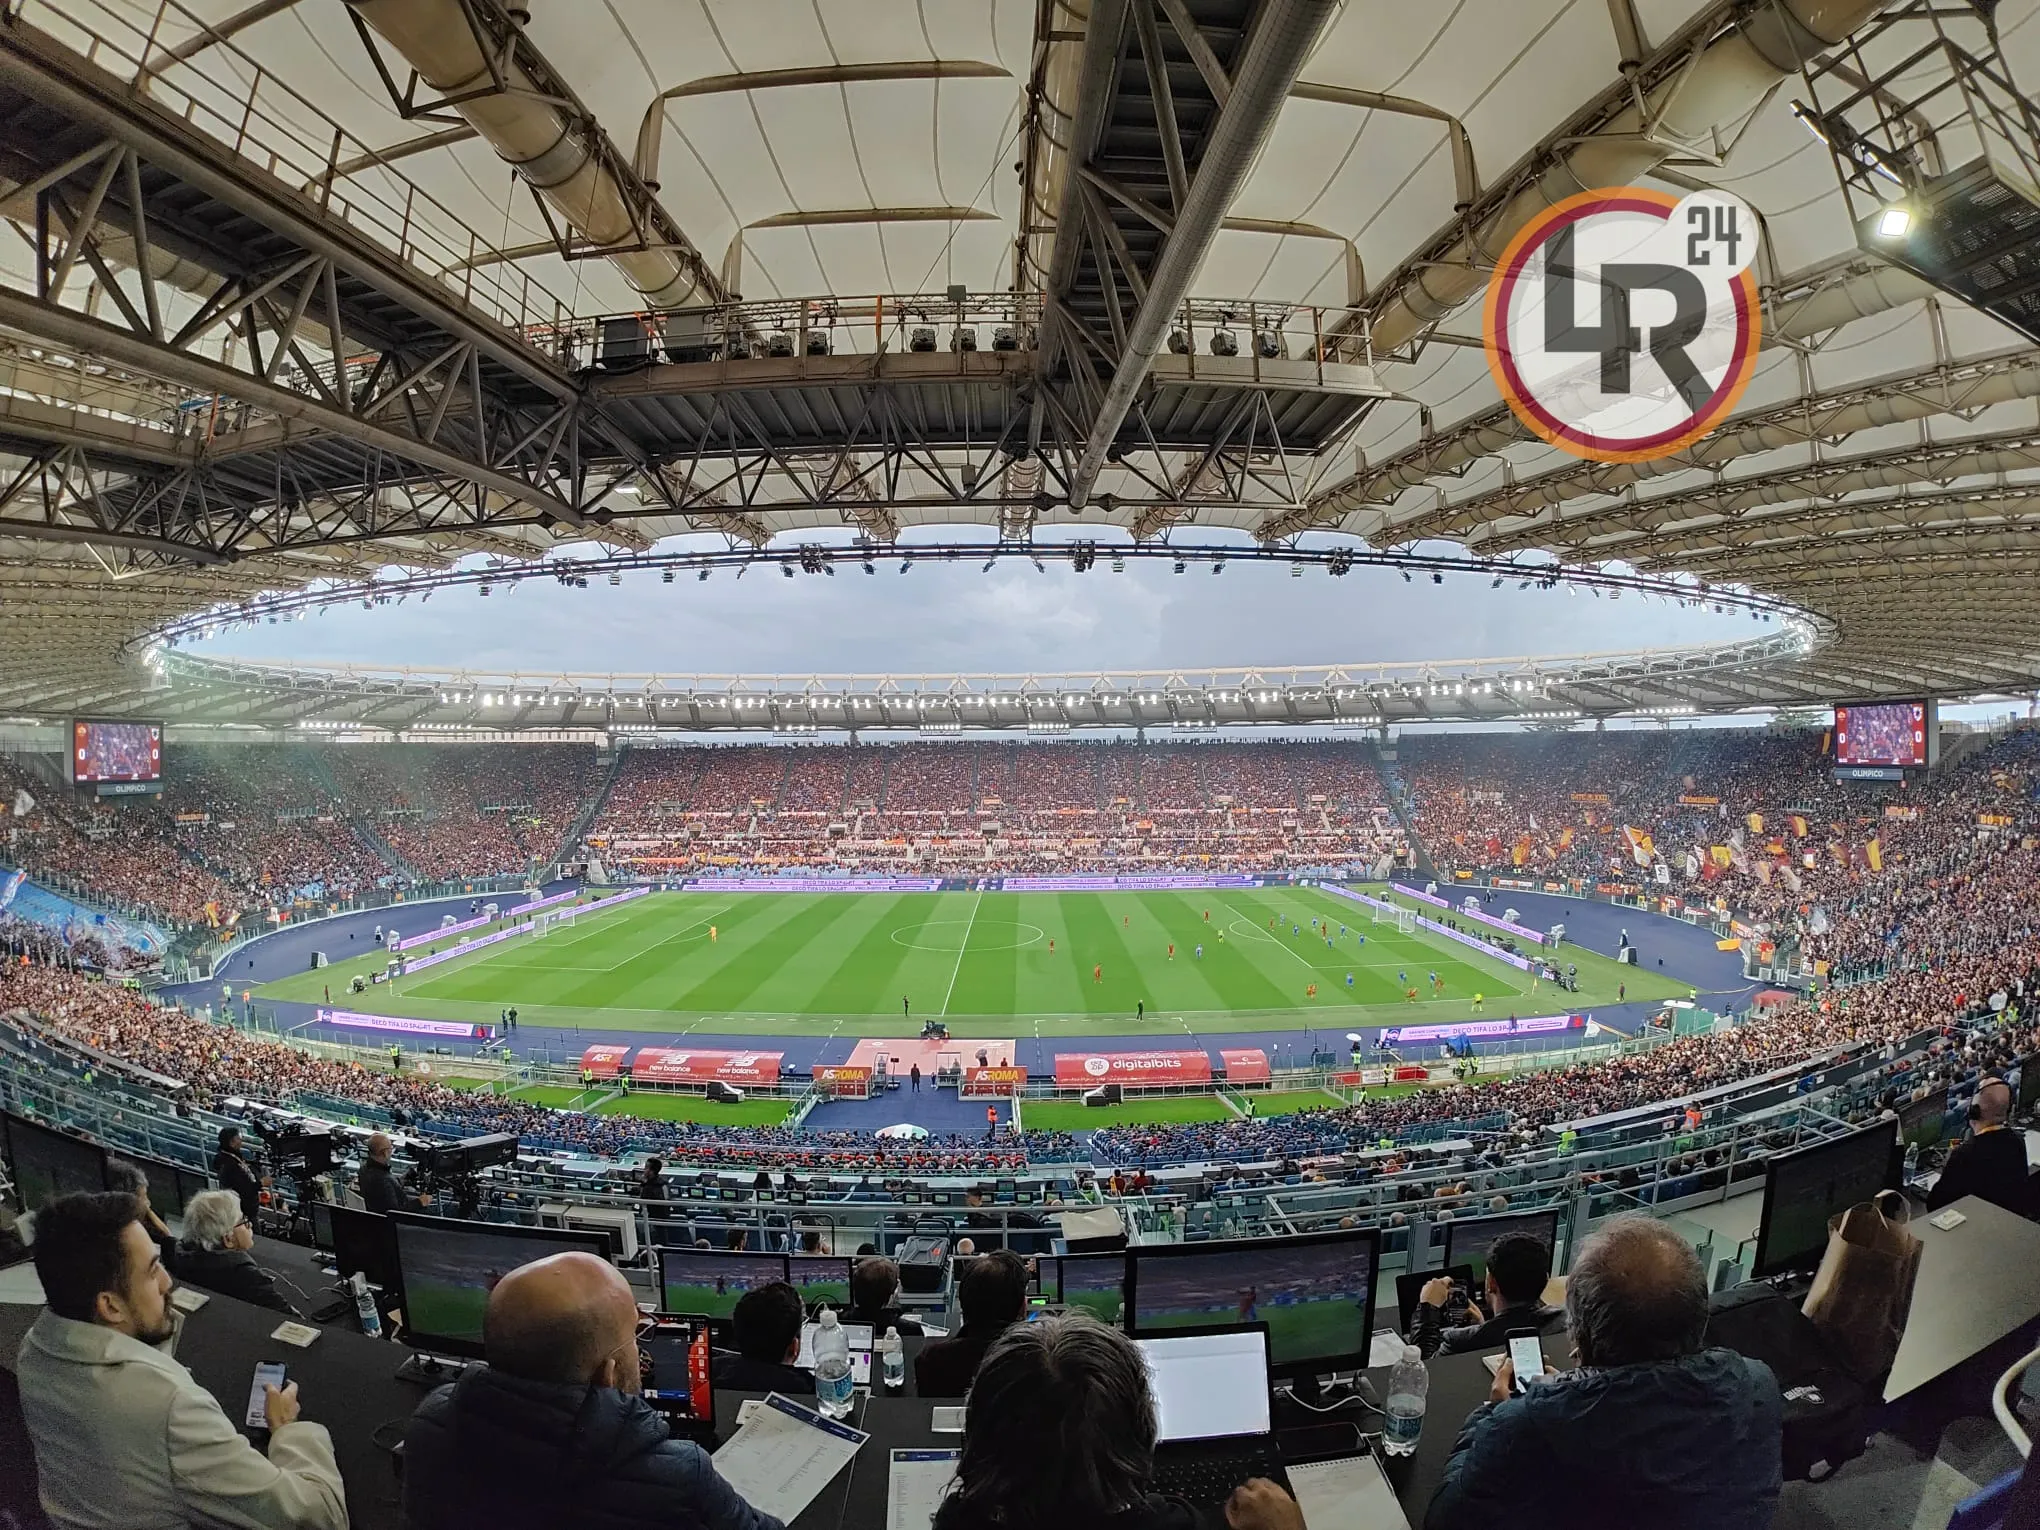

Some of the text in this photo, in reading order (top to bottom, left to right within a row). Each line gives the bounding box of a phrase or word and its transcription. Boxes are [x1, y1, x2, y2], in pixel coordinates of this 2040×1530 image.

[1840, 733, 1846, 744] 0
[1915, 731, 1922, 742] 0
[78, 748, 85, 760] 0
[152, 749, 158, 760] 0
[116, 784, 146, 793] OLIMPICO
[1113, 1059, 1182, 1071] digitalbits
